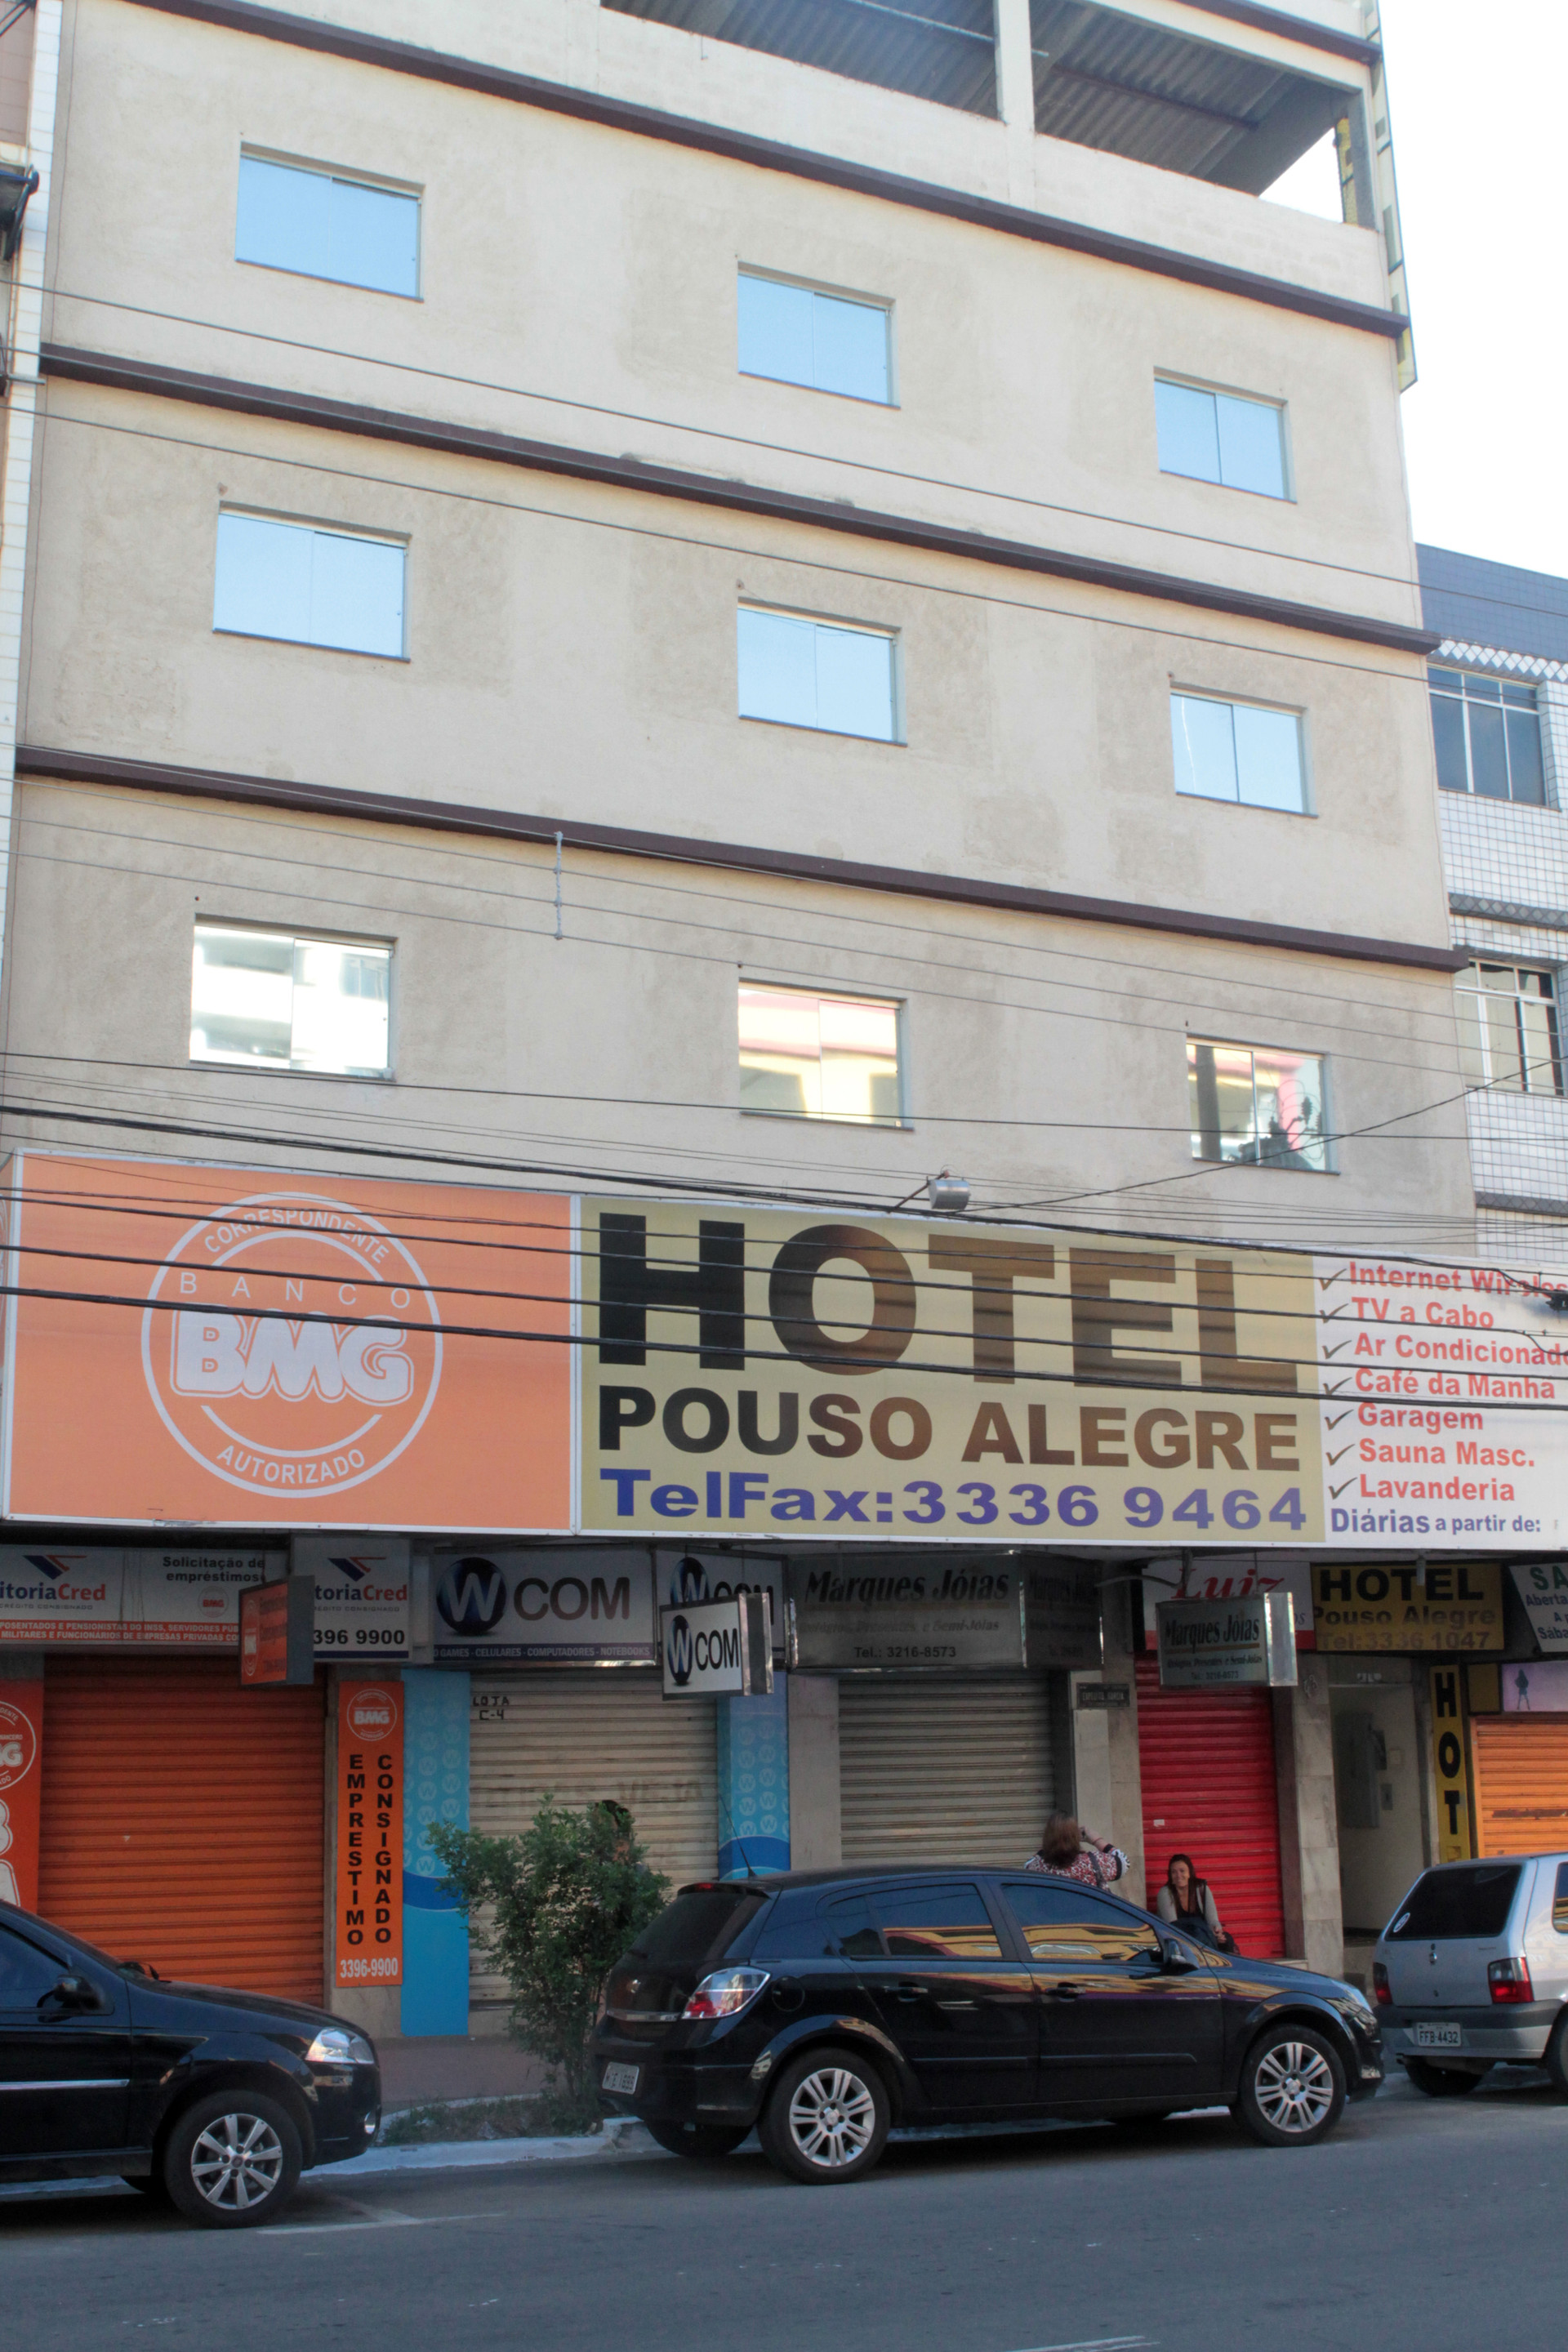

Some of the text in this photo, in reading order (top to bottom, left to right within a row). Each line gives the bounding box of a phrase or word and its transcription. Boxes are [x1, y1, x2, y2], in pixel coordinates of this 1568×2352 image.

[203, 1207, 390, 1264] CORRESPONDENTE
[1349, 1261, 1461, 1292] Internet
[180, 1272, 411, 1310] BANCO
[599, 1212, 1298, 1393] HOTEL
[1351, 1297, 1494, 1329] TV a Cabo
[171, 1304, 414, 1405] BMG
[1354, 1332, 1386, 1356] Ar
[1355, 1368, 1419, 1394] Café
[1428, 1371, 1461, 1396] da
[599, 1385, 1300, 1472] POUSO ALEGRE
[1357, 1401, 1484, 1435] Garagem
[216, 1445, 366, 1486] AUTORIZADO
[1359, 1437, 1535, 1468] Sauna Masc.
[1360, 1473, 1515, 1501] Lavanderia
[1123, 1486, 1307, 1531] 9464
[1331, 1508, 1431, 1534] Diárias
[1435, 1519, 1446, 1532] a
[1452, 1515, 1507, 1535] partir
[1512, 1516, 1541, 1532] de:
[163, 1555, 265, 1570] Solicitação de
[166, 1570, 259, 1583] empréstimos
[0, 1581, 106, 1601] itoriaCred
[314, 1584, 408, 1601] toriaCred
[805, 1571, 926, 1612] Marques
[932, 1568, 1009, 1601] Jóias
[1170, 1567, 1285, 1599] Luiz
[1320, 1568, 1484, 1601] HOTEL
[168, 1624, 220, 1633] SERVIDORES
[1313, 1606, 1495, 1630] Pouso Alegre
[2, 1631, 47, 1639] MILITARES
[356, 1629, 405, 1645] 9900
[1165, 1619, 1220, 1654] Marques
[1432, 1632, 1490, 1650] 1047
[440, 1648, 470, 1657] GAMES
[475, 1647, 521, 1657] CELULARES
[527, 1646, 595, 1657] COMPUTADORES
[600, 1646, 650, 1656] NOTEBOOKS
[887, 1646, 956, 1658] 3216-8573
[473, 1696, 510, 1706] LOJA
[479, 1709, 505, 1720] C-4
[354, 1710, 390, 1725] BMG
[346, 1753, 366, 1945] EMPRESTIMO
[374, 1753, 394, 1944] CONSIGNADO
[340, 1957, 399, 1978] 3396-9900
[1419, 2031, 1459, 2043] FFB-4432
